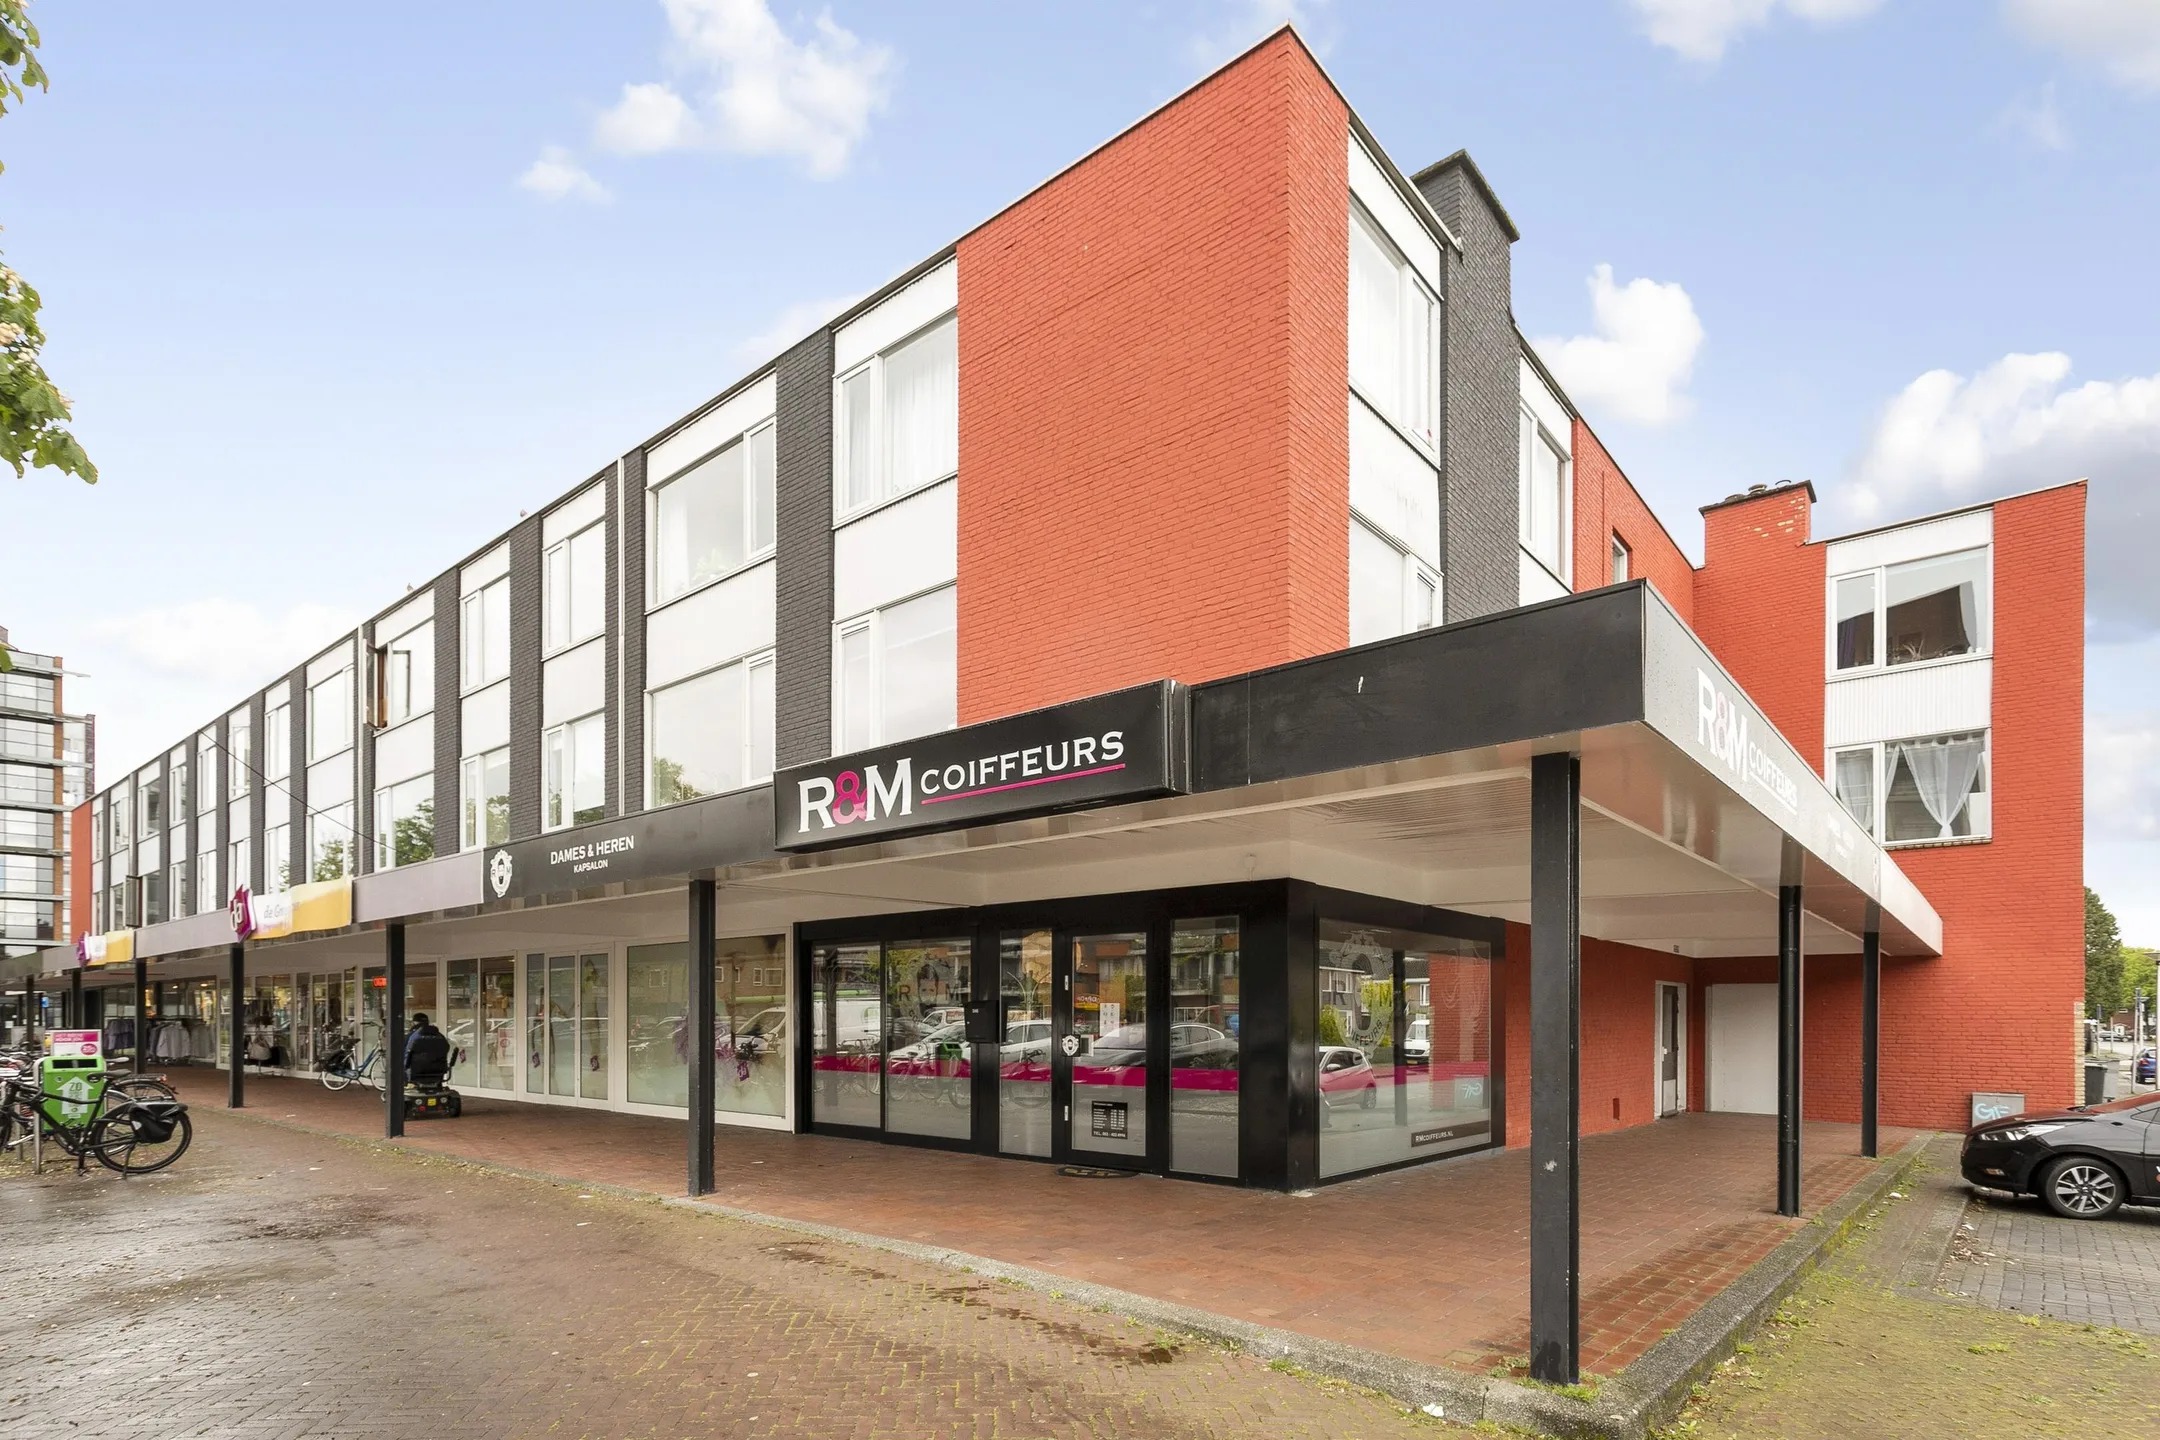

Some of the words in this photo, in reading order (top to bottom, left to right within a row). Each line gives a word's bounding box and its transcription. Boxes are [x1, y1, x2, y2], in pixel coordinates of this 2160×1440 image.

[1696, 666, 1748, 783] R&M
[1749, 740, 1799, 808] COIFFEURS
[797, 757, 913, 833] R&M
[919, 730, 1125, 795] COIFFEURS
[550, 845, 586, 865] DAMES
[587, 843, 595, 858] &
[596, 835, 635, 856] HEREN
[573, 859, 609, 873] KAPSALON
[230, 899, 244, 932] da
